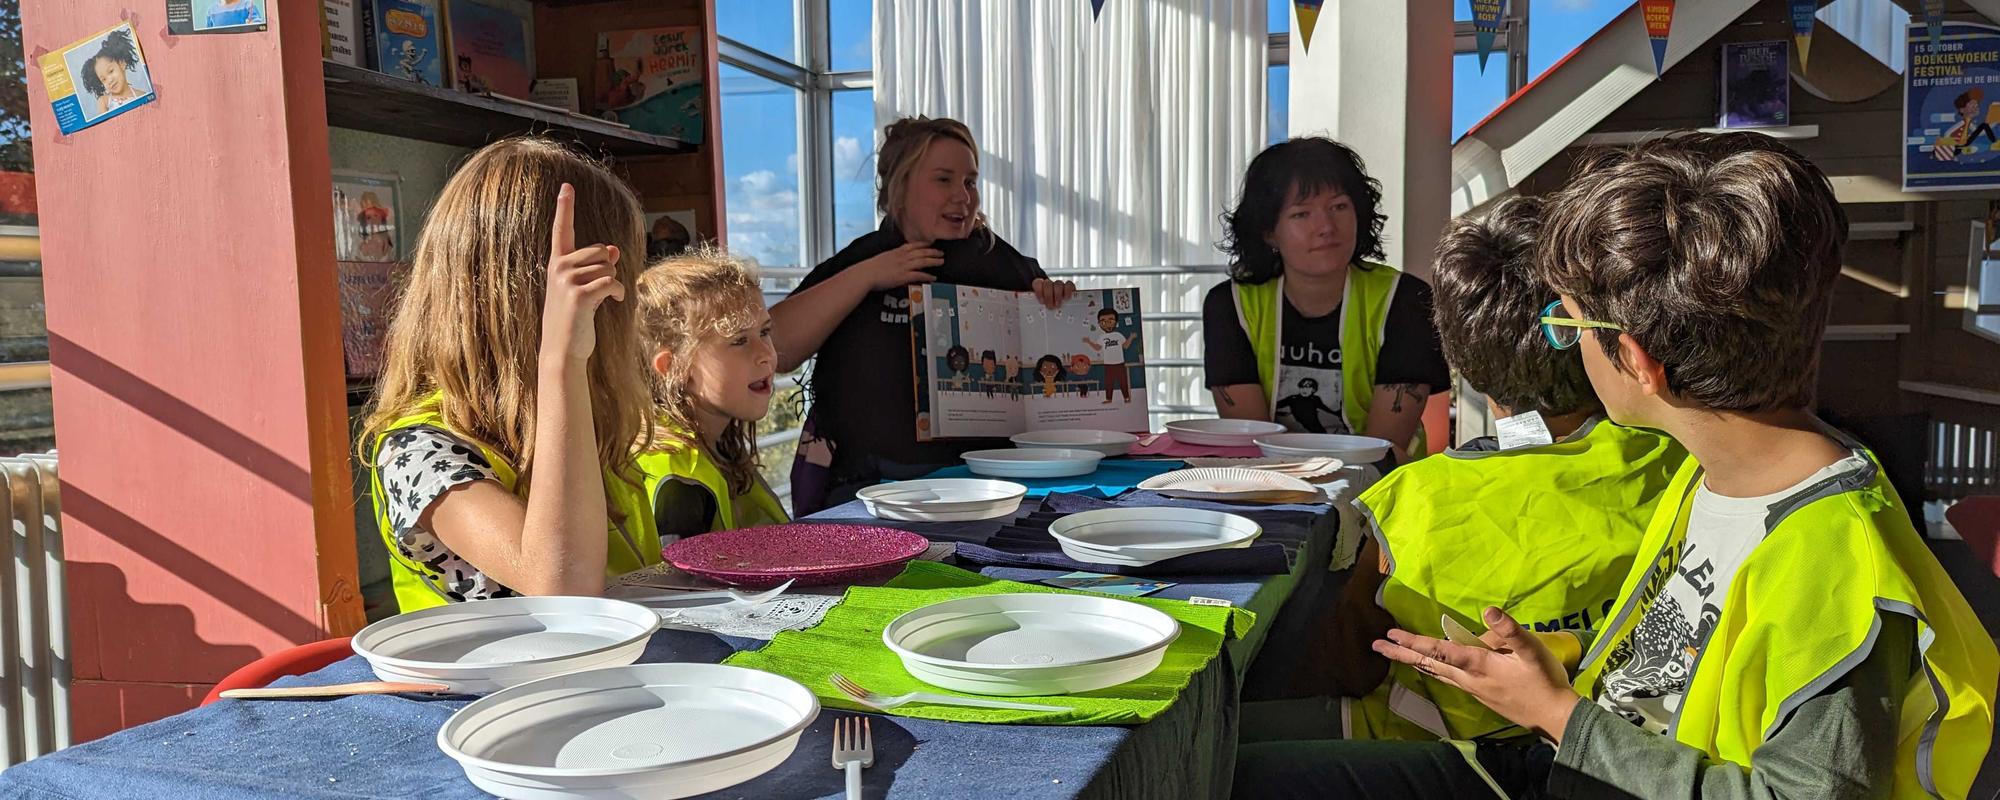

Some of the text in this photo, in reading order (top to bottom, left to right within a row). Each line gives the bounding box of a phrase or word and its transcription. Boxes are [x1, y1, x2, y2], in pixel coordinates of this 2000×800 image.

[1914, 43, 1963, 53] 15 OTOBER
[1914, 52, 1998, 65] BOEKIEWOEKIE
[1914, 66, 1963, 77] FESTIVAL
[1930, 77, 1962, 86] FEESTJE
[1964, 76, 1973, 84] IN
[1974, 75, 1985, 84] DE
